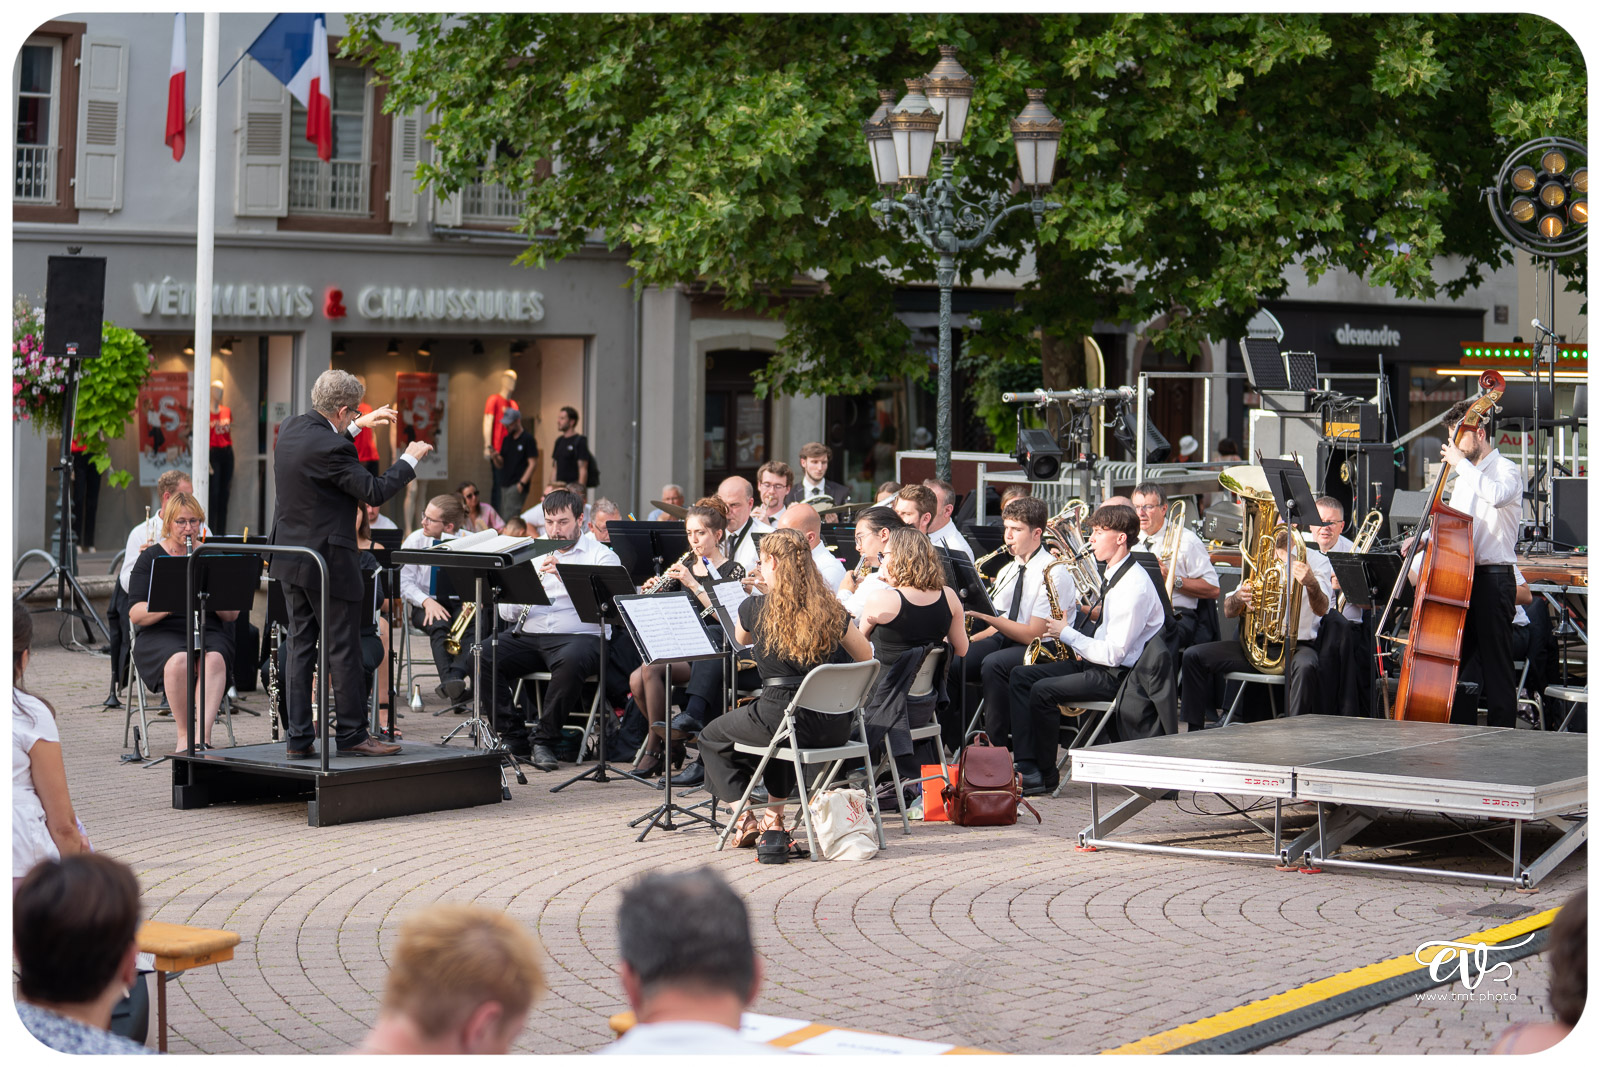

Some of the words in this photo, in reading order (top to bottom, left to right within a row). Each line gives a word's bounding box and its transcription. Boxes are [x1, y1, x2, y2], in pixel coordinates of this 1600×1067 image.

[133, 276, 313, 317] VÊTMENTS
[324, 286, 347, 318] &
[358, 286, 544, 321] CHAUSSURES
[1336, 323, 1401, 346] alexandre
